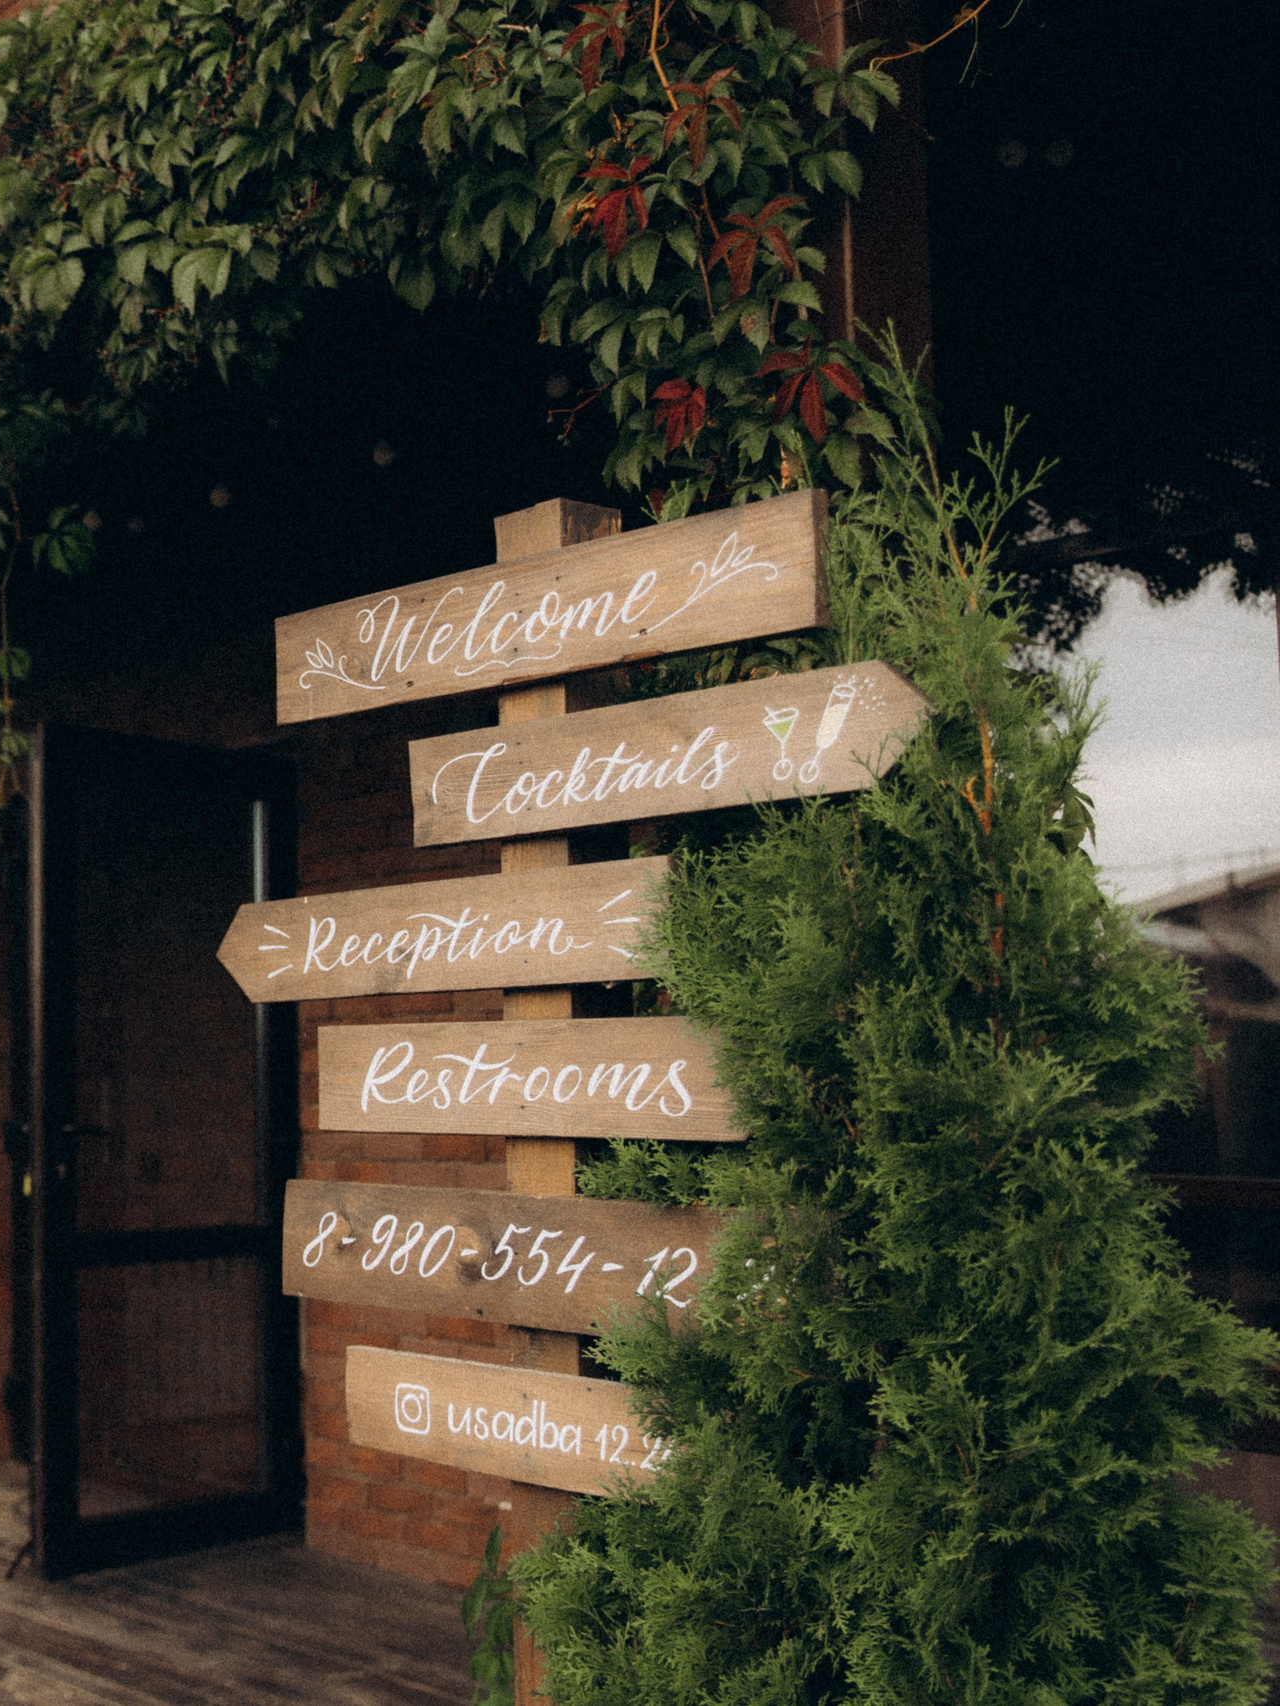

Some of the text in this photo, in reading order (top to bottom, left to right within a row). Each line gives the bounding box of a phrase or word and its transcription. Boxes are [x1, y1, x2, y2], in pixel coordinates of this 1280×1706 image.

[355, 569, 658, 683] Welcome
[431, 726, 739, 824] Cocktails
[302, 906, 592, 979] Reception
[360, 1041, 694, 1117] Restrooms
[302, 1210, 796, 1310] 8-980-554-12
[446, 1400, 582, 1456] usadba
